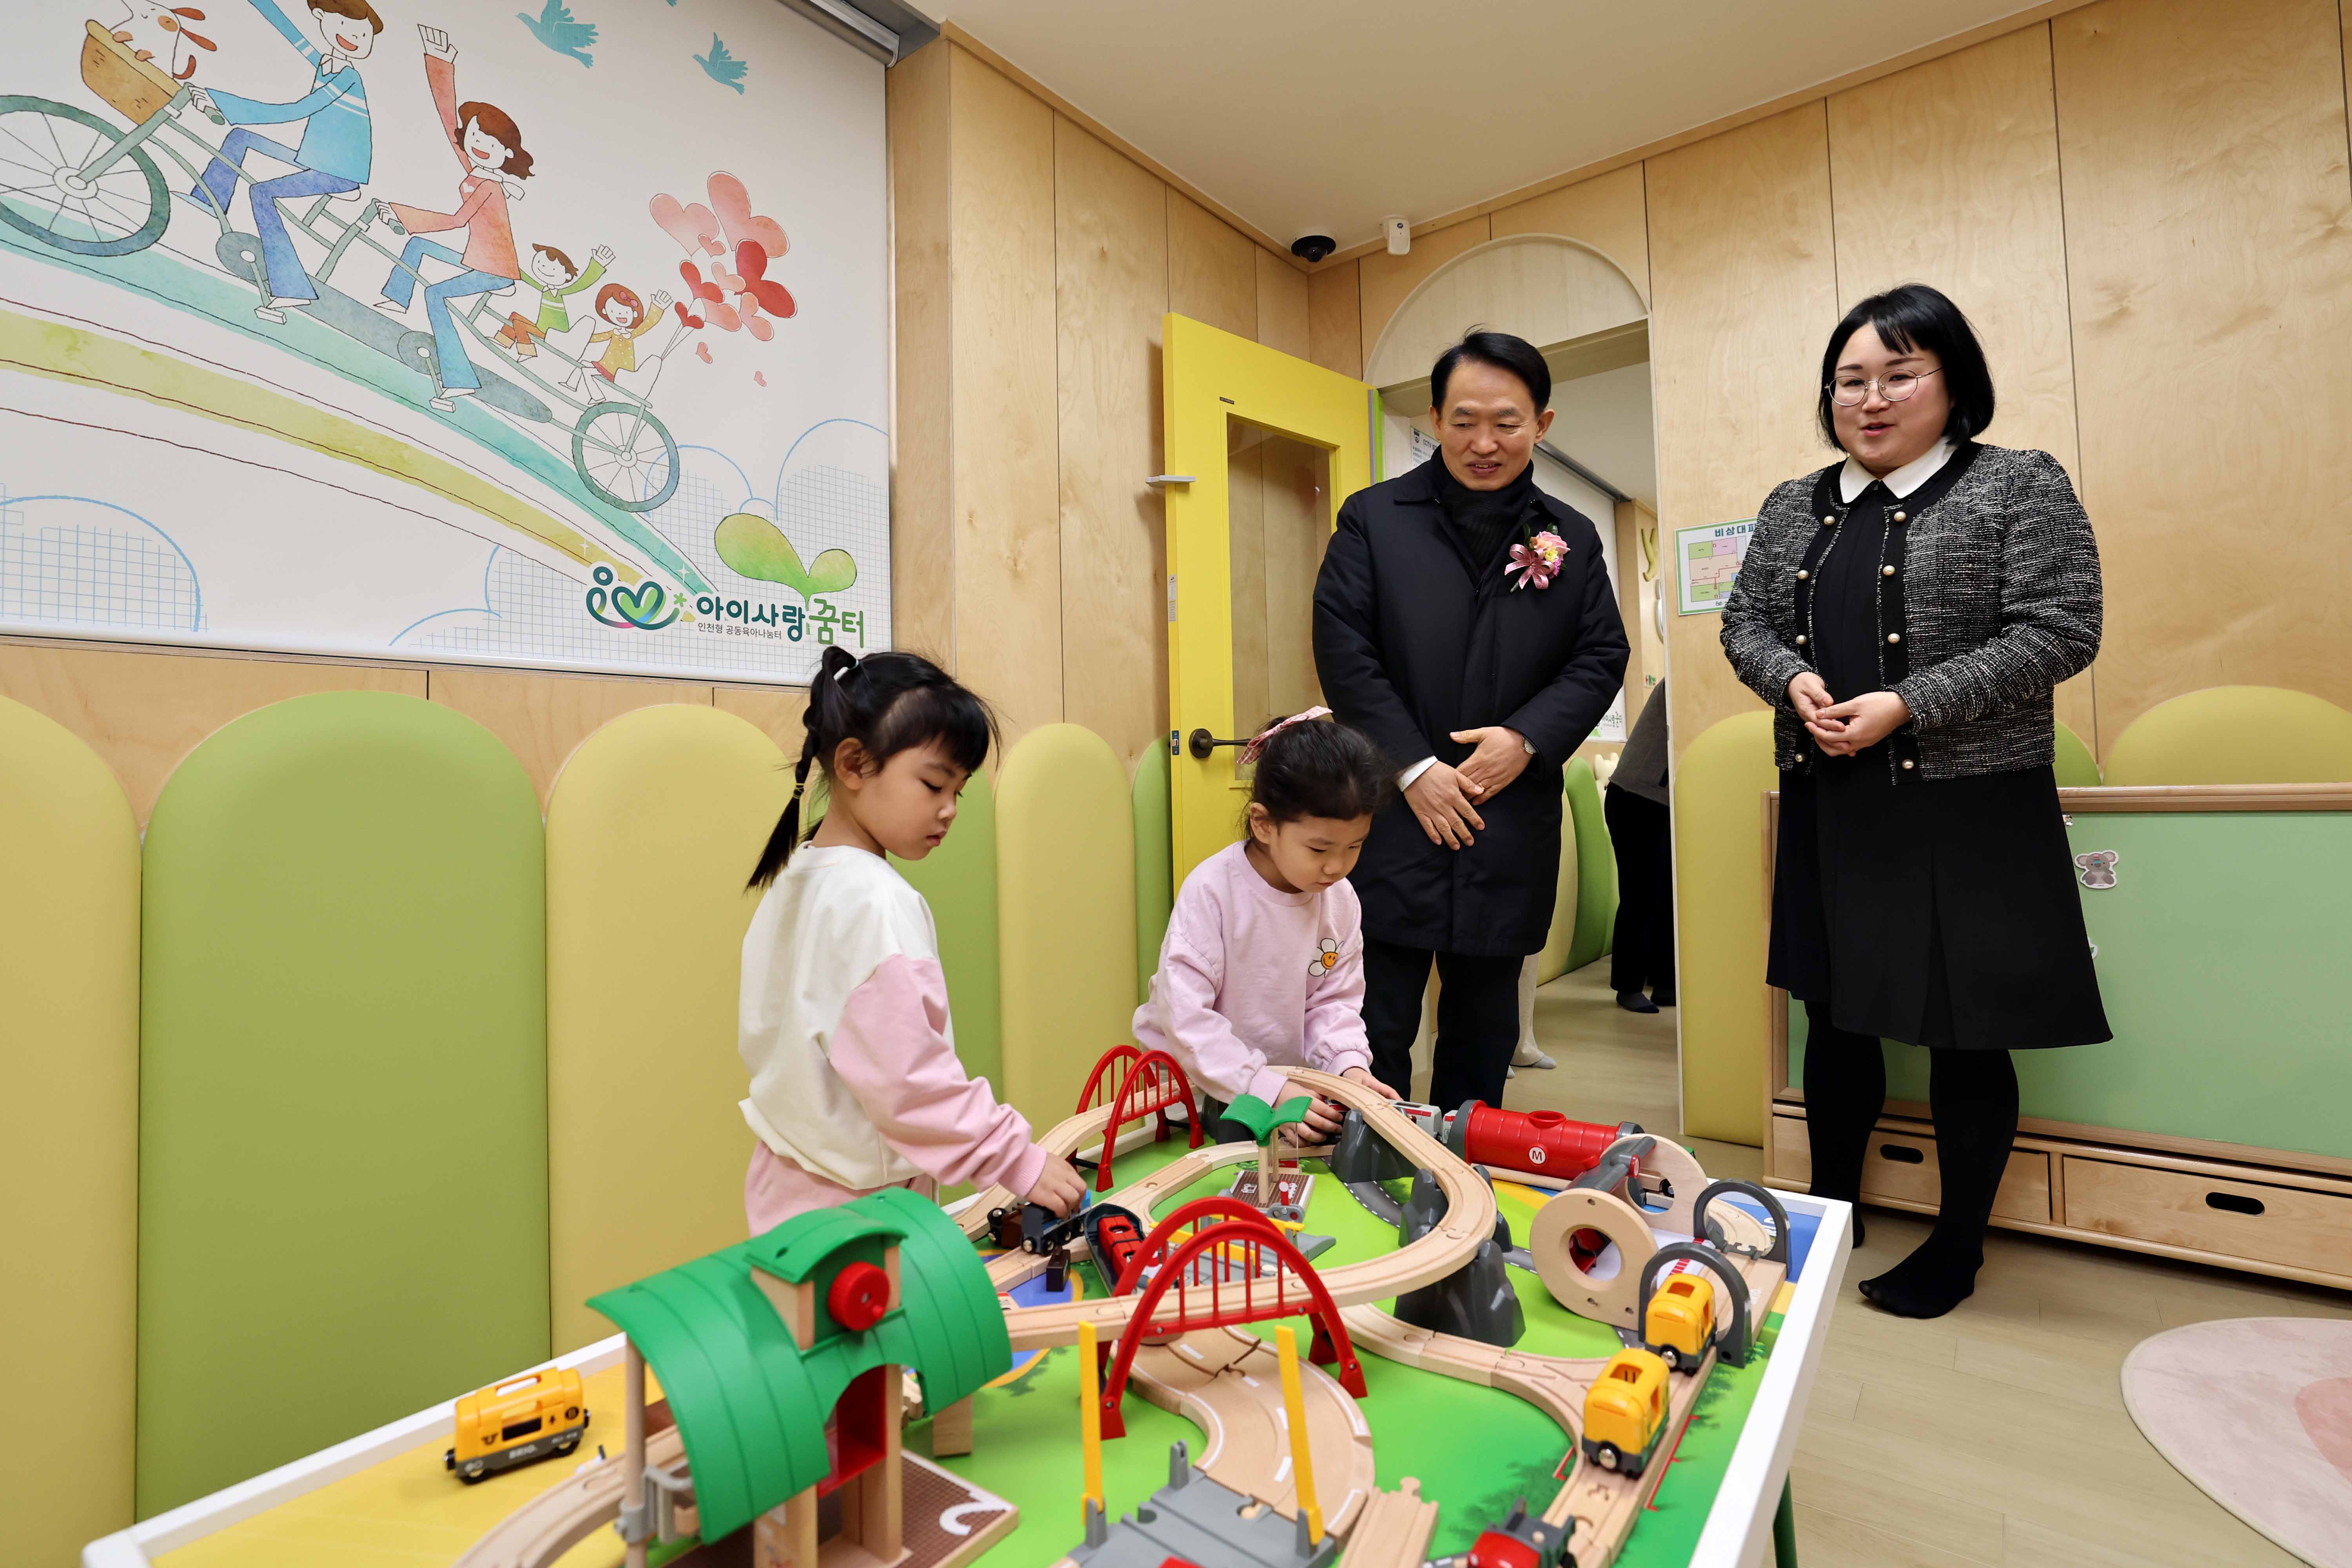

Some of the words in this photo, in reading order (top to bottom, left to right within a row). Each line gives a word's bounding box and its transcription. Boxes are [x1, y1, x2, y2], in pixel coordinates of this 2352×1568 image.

[1423, 439, 1432, 448] CCTV
[697, 597, 864, 648] 아이사랑꿈터
[698, 622, 723, 634] 인천형
[726, 625, 781, 639] 공동육아나눔터
[1532, 1150, 1543, 1161] M
